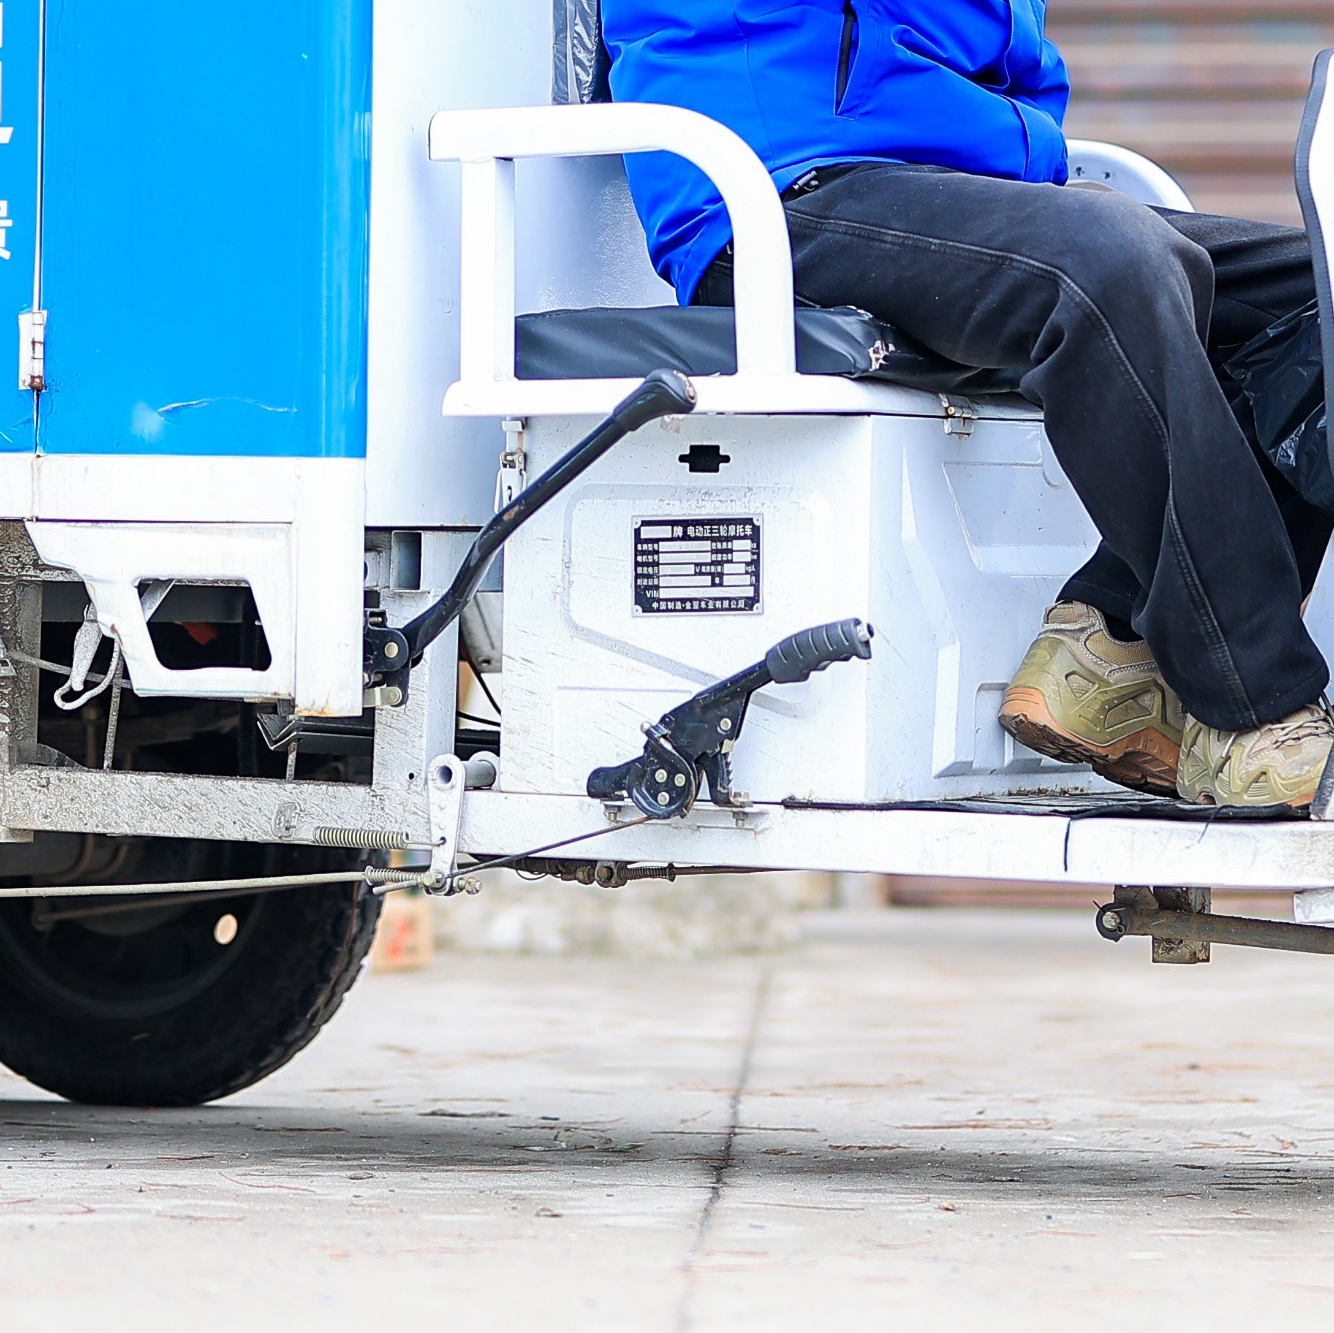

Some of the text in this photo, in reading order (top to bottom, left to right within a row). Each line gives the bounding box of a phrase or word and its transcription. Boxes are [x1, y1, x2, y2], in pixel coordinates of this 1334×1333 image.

[687, 524, 753, 538] 电动正三轮摩托车
[646, 589, 659, 598] VIN
